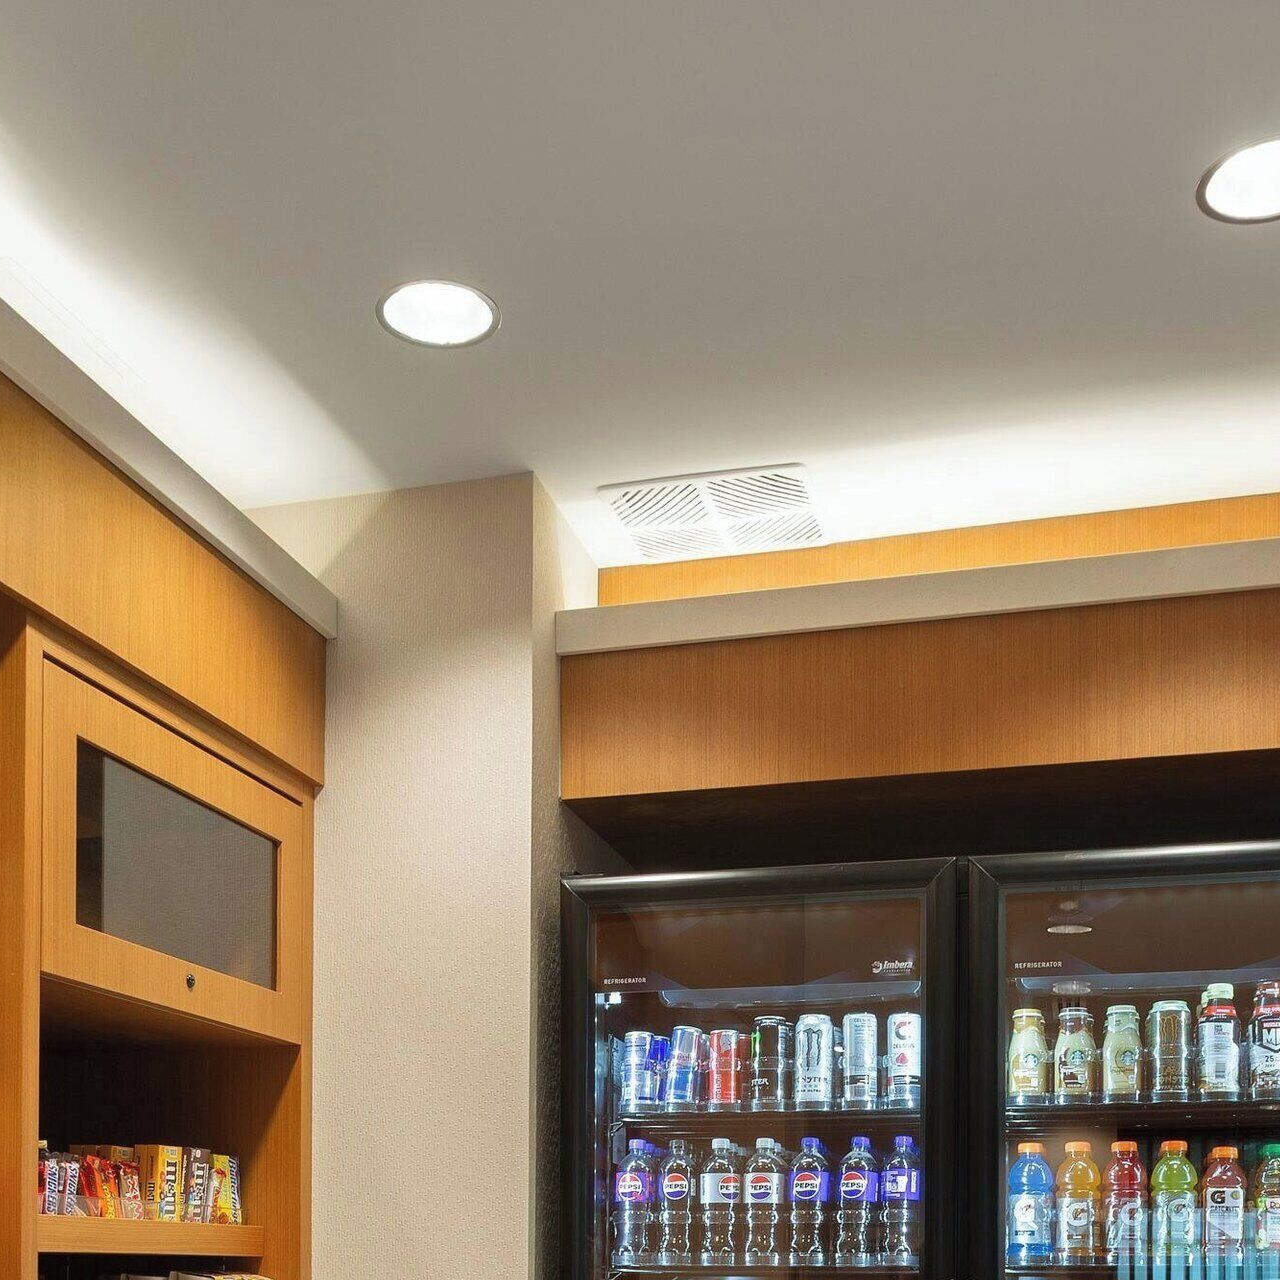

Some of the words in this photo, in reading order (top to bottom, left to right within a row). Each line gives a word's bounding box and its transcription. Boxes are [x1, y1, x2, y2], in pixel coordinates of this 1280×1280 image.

[883, 960, 914, 969] Imbera
[1014, 961, 1063, 969] REFRIGERATOR
[603, 976, 647, 985] REFRIGERATOR
[794, 1182, 818, 1190] PEPSI
[841, 1182, 864, 1190] PEPSI
